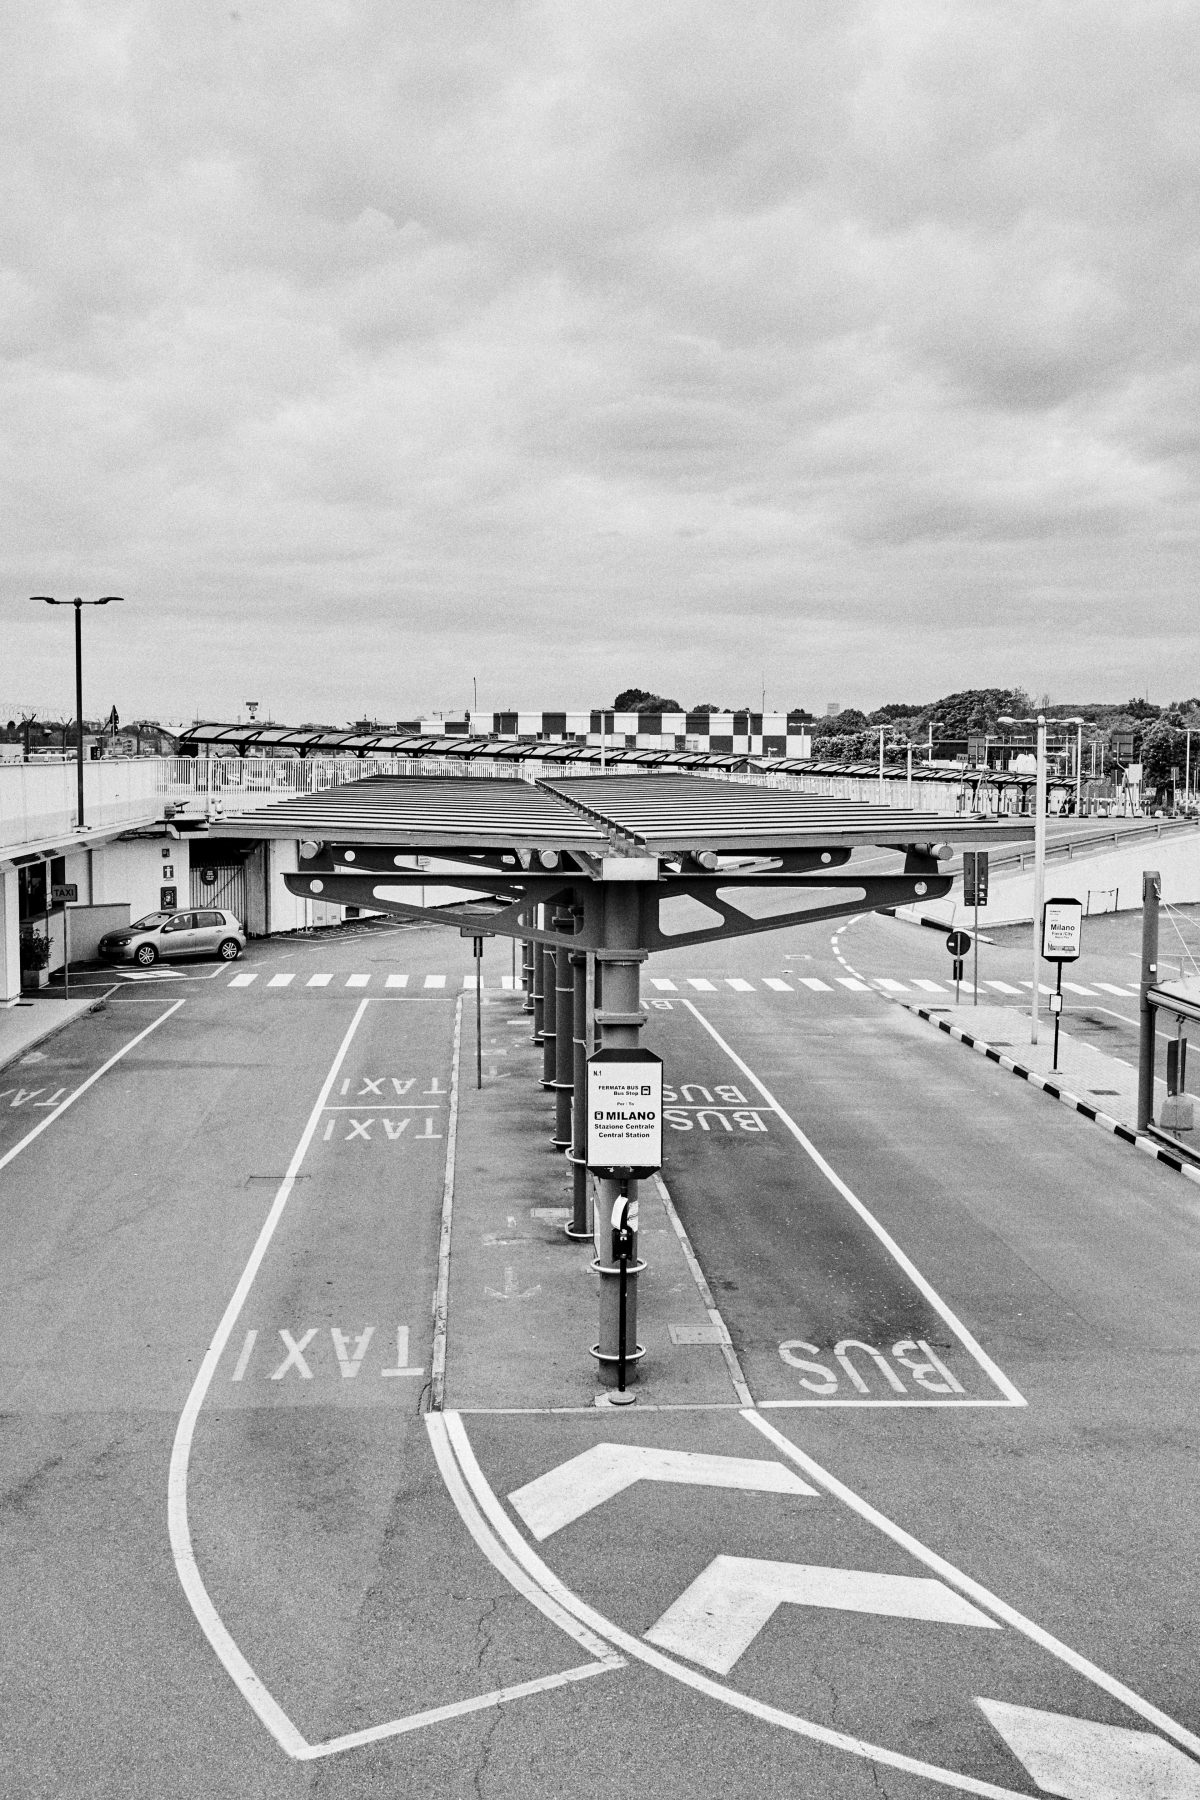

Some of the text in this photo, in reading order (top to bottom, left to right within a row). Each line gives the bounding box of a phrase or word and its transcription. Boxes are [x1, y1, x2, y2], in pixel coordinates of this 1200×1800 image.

[53, 888, 74, 897] TAXI
[1050, 923, 1075, 931] Milano
[339, 1077, 447, 1095] TAXI
[606, 1111, 656, 1121] MILANO
[663, 1110, 768, 1132] BUS
[323, 1117, 443, 1140] TAXI
[231, 1325, 425, 1382] TAXI
[778, 1339, 966, 1394] BUS
